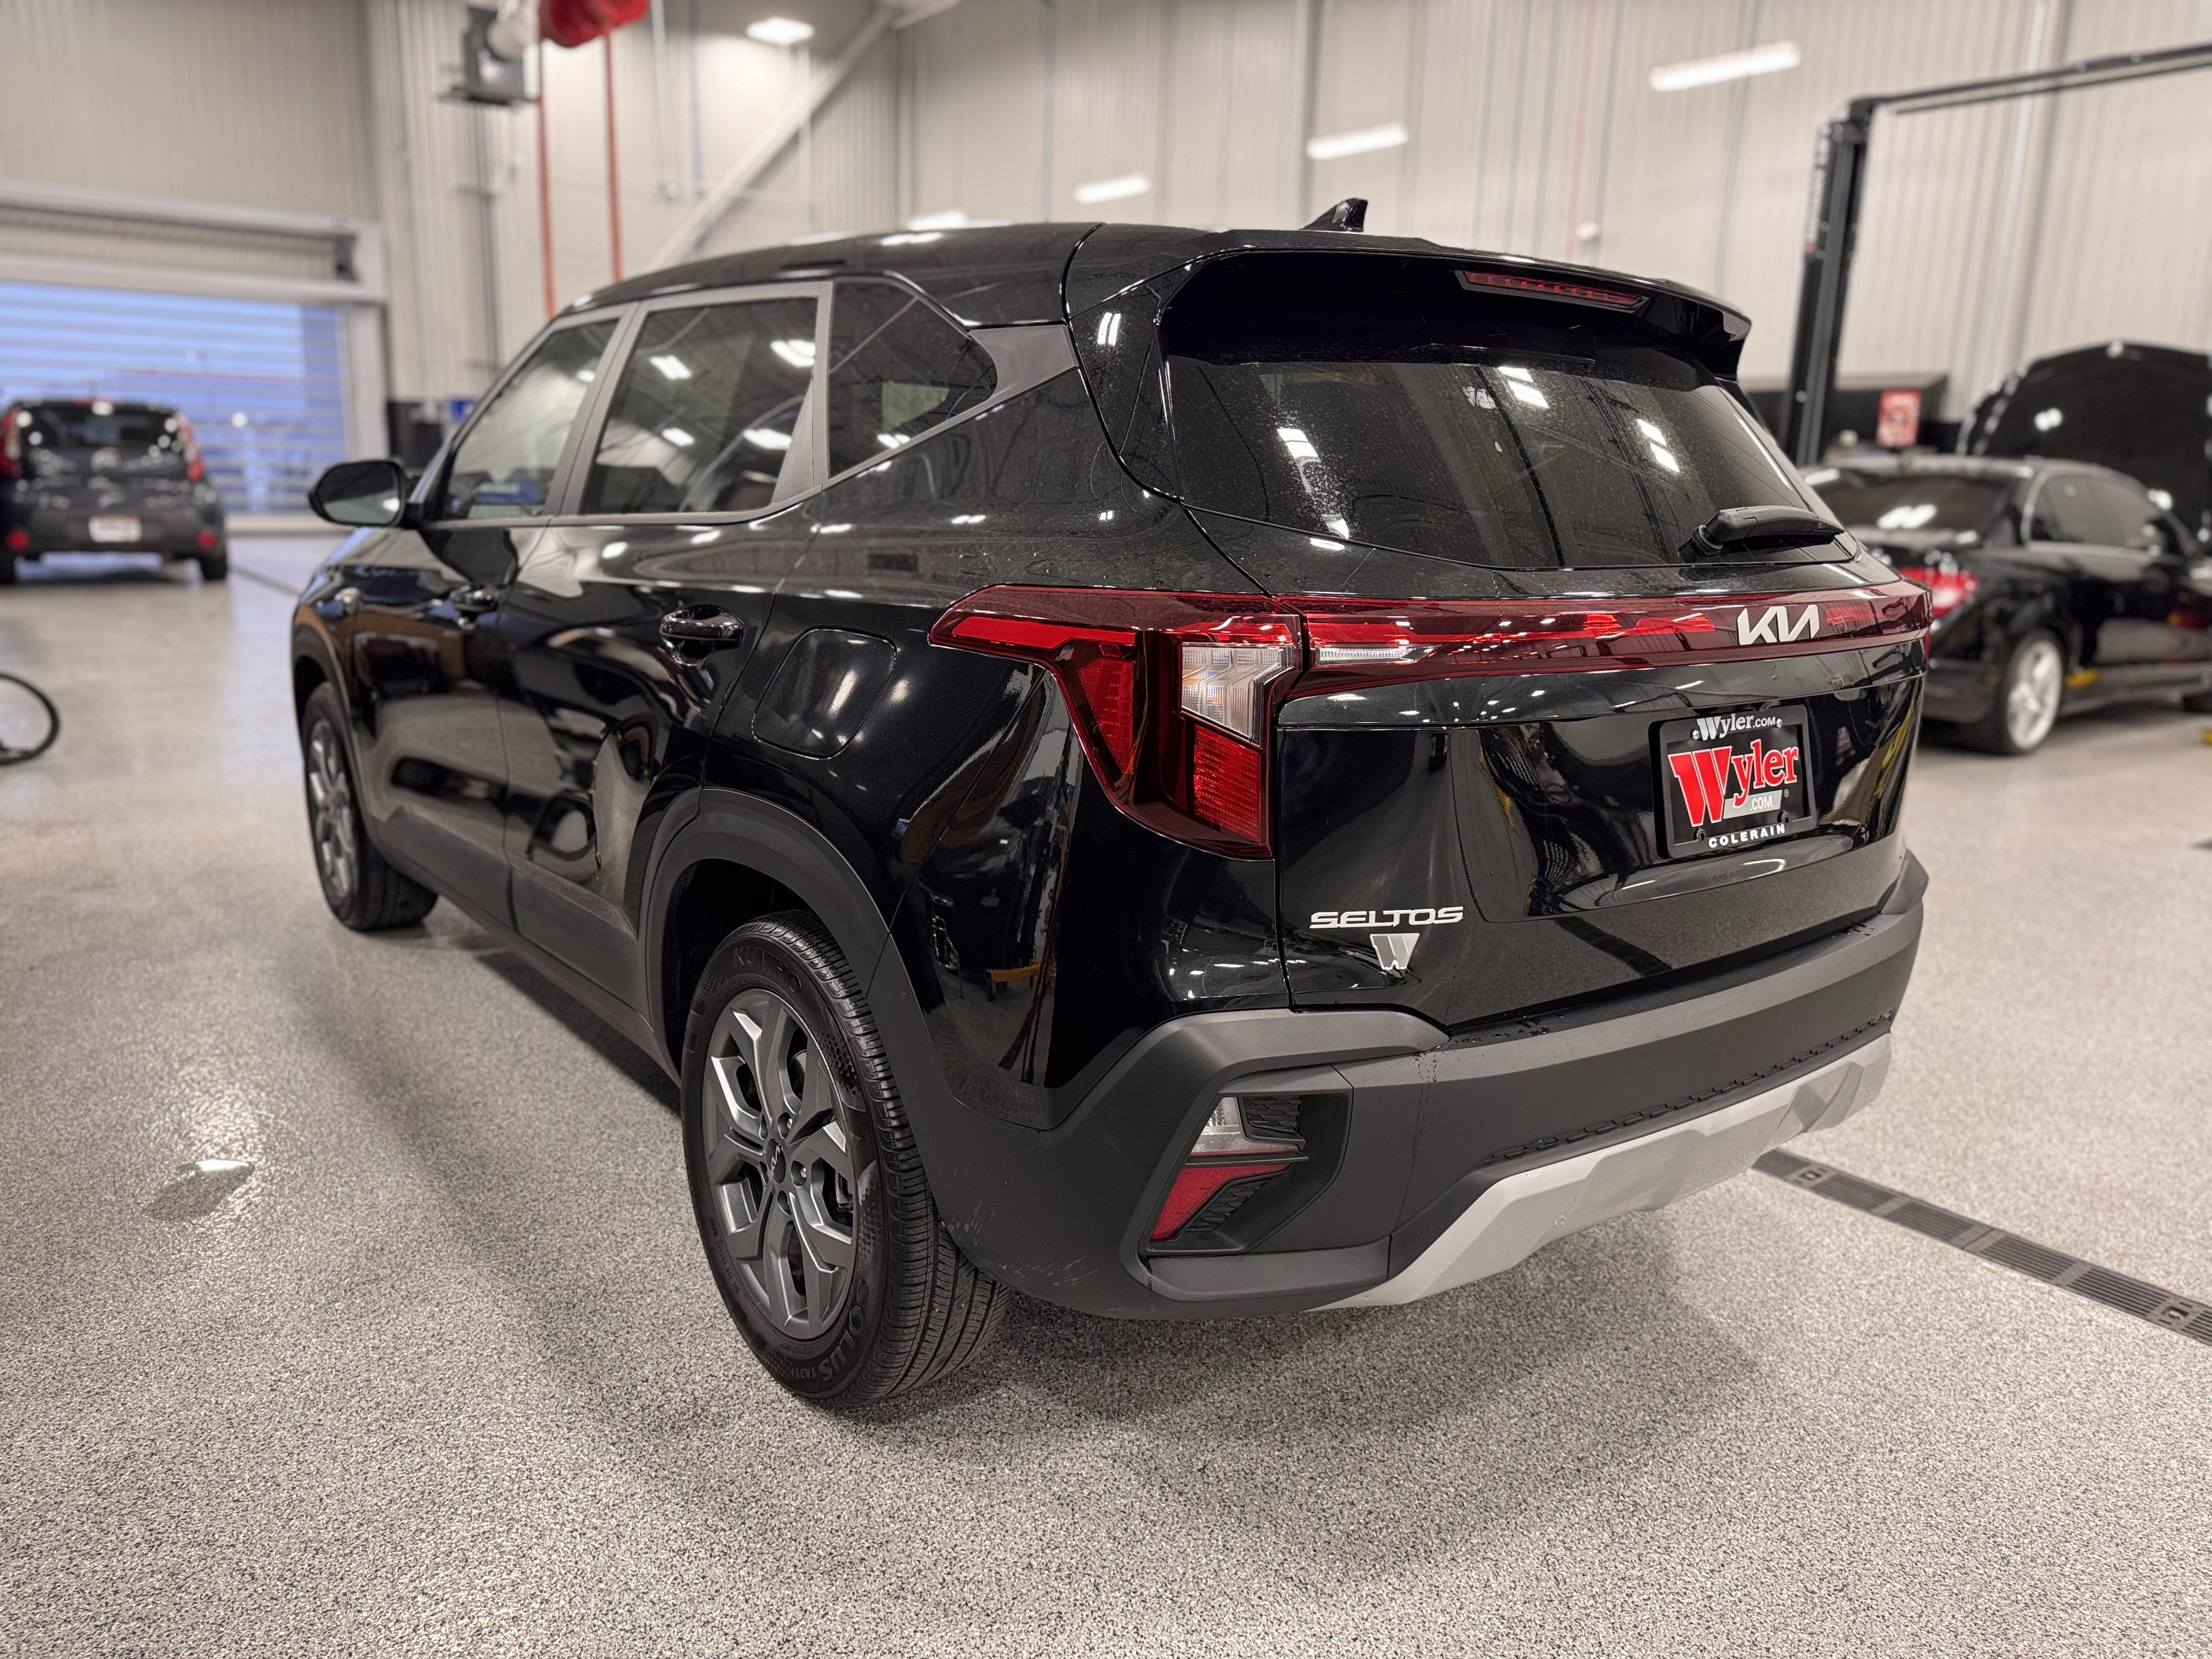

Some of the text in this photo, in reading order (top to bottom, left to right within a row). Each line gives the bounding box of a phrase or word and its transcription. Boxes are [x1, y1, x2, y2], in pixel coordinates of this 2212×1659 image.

[1737, 605, 1820, 646] KIA
[1668, 739, 1799, 827] Wyler
[1708, 824, 1785, 848] COLERAIN
[1310, 906, 1464, 929] SELTOS
[819, 1278, 869, 1381] SOLUS
